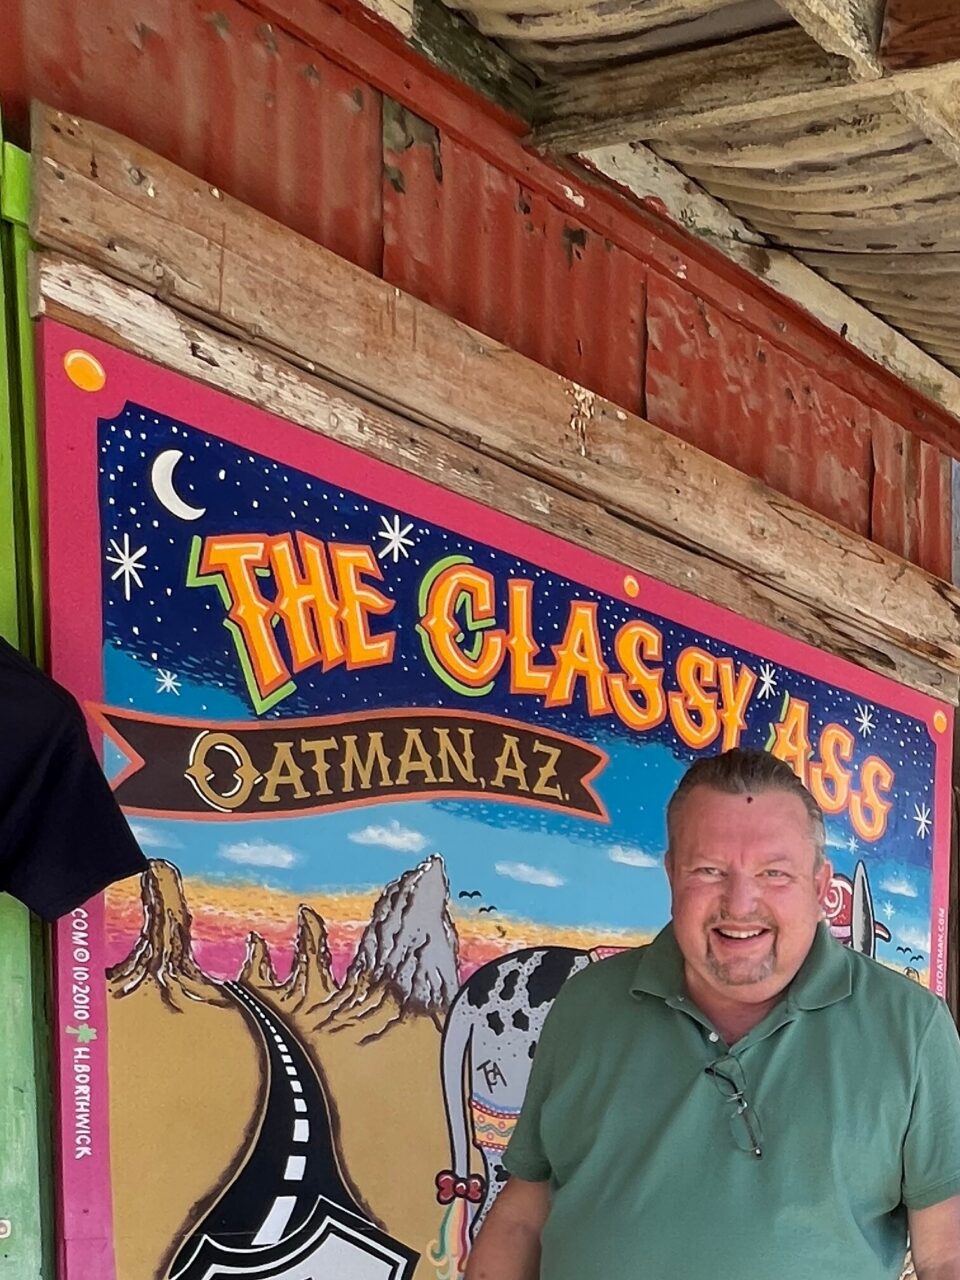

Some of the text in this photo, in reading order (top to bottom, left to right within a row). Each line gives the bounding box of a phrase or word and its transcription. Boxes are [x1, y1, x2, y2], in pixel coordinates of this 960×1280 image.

[187, 529, 895, 843] THE CLASSY ASS
[73, 1046, 93, 1160] H.BORTHWICK
